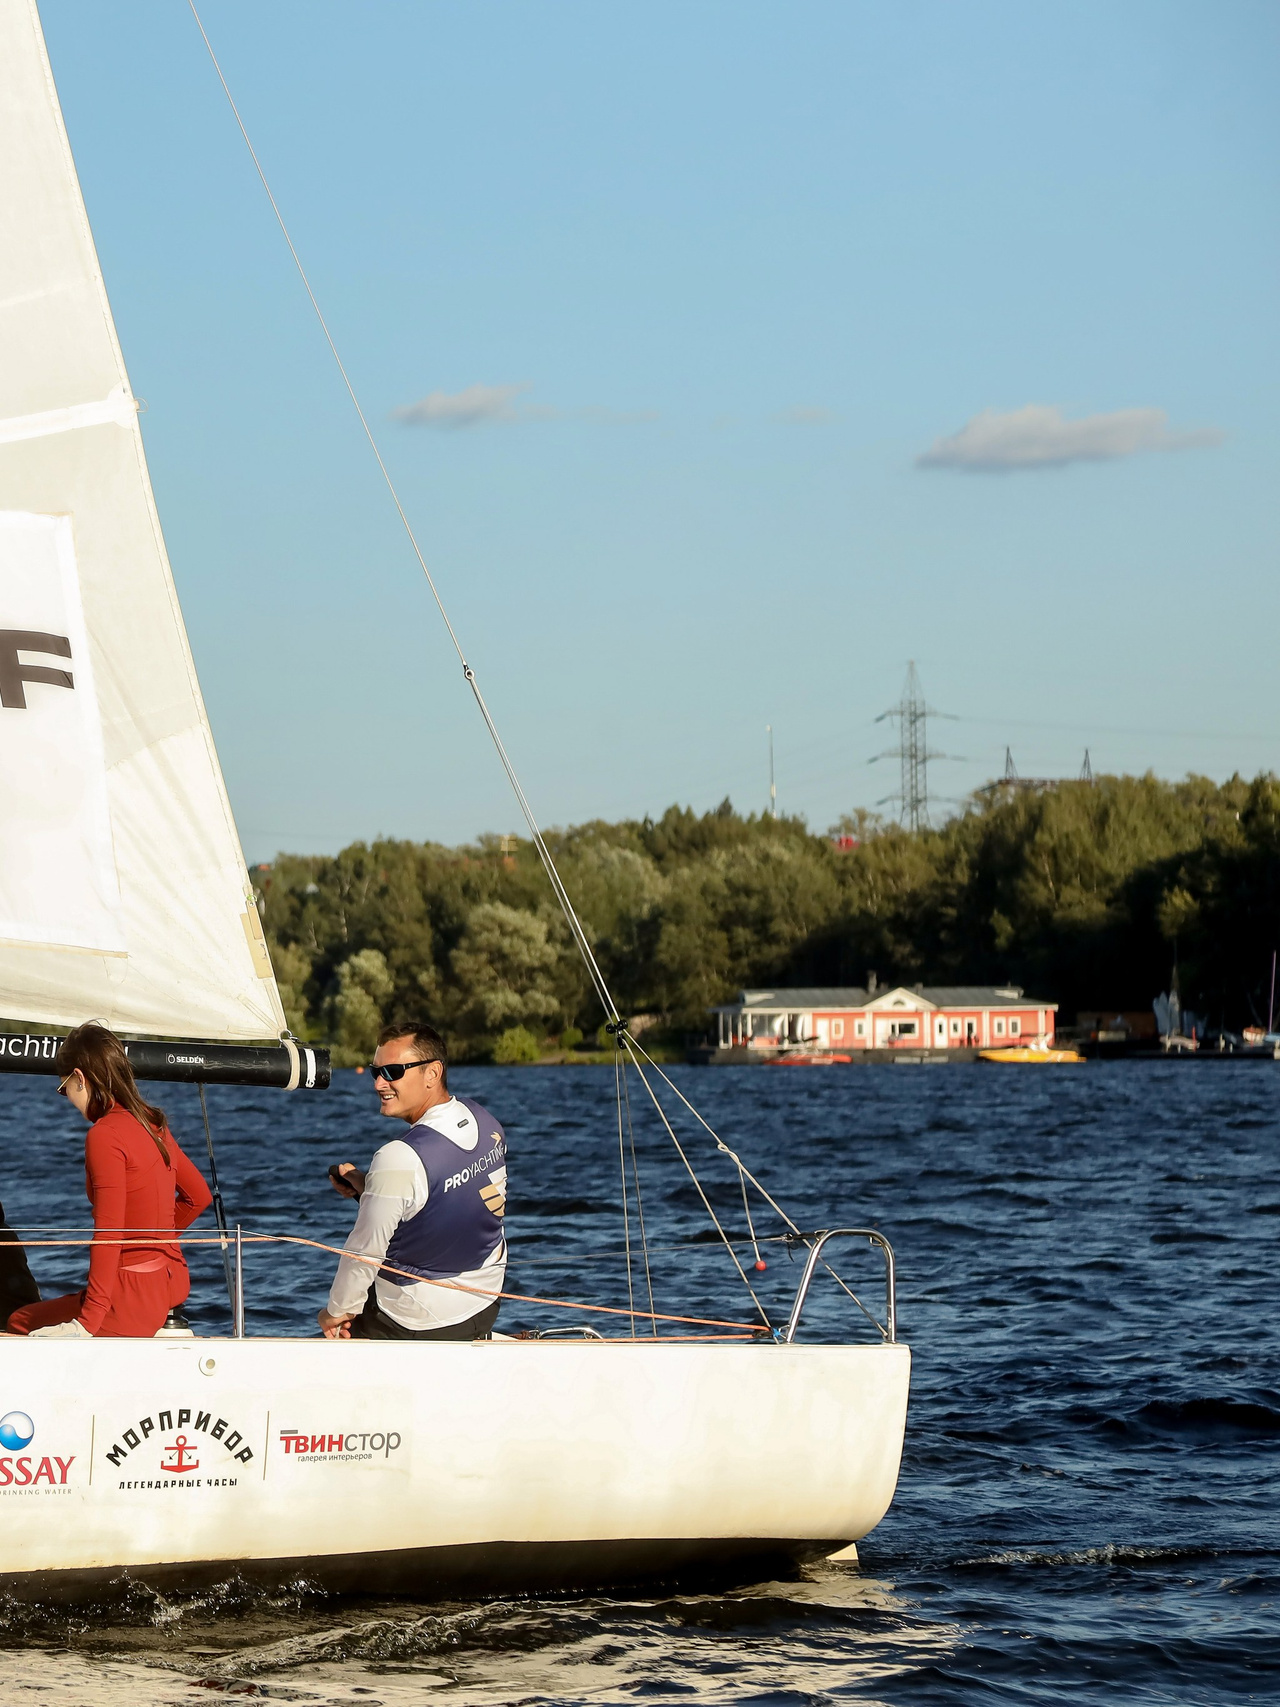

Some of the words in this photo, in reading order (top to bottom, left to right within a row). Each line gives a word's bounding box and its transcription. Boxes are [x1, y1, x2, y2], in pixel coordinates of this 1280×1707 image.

[176, 1055, 204, 1064] SELDÉN
[106, 1409, 254, 1467] МОРПРИБОР
[298, 1454, 327, 1463] галерея
[329, 1453, 373, 1462] интерьеров
[119, 1480, 201, 1489] ЛЕГЕНДАРНЫЕ
[207, 1478, 238, 1487] ЧАСЫ
